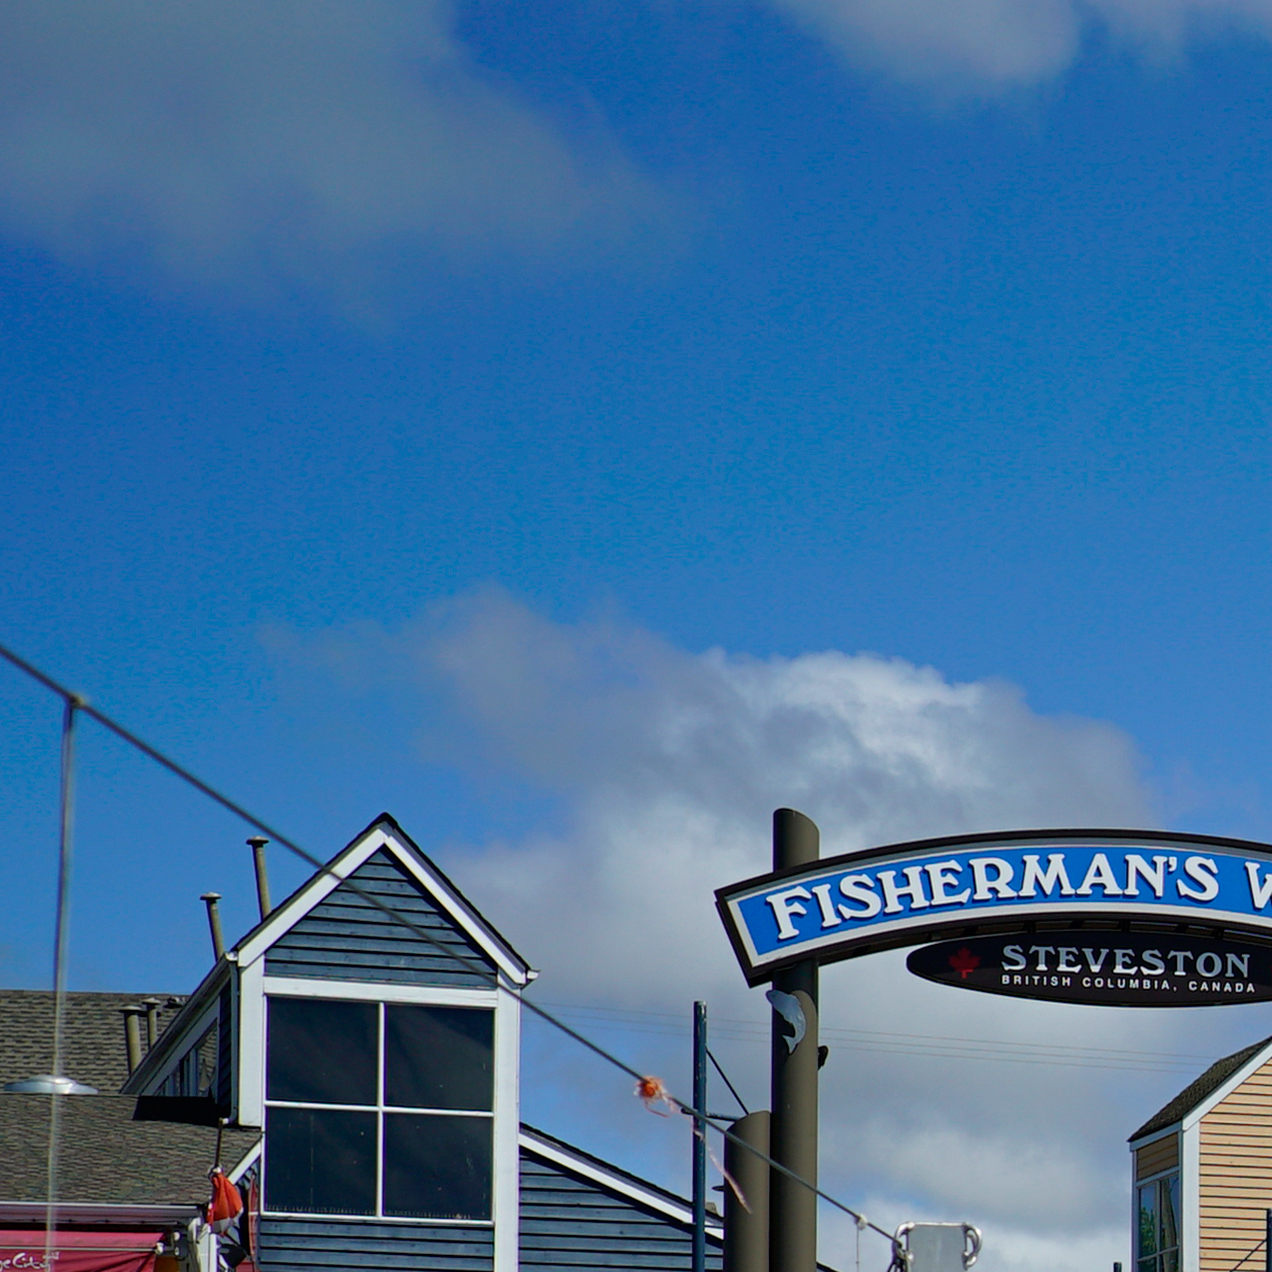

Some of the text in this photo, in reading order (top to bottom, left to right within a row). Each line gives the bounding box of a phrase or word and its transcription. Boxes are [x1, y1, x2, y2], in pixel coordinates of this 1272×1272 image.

[766, 853, 1219, 941] FISHERMAN'S
[1001, 945, 1250, 978] STEVESTON
[1001, 975, 1256, 993] BRITISH COLUMBIA, CANADA
